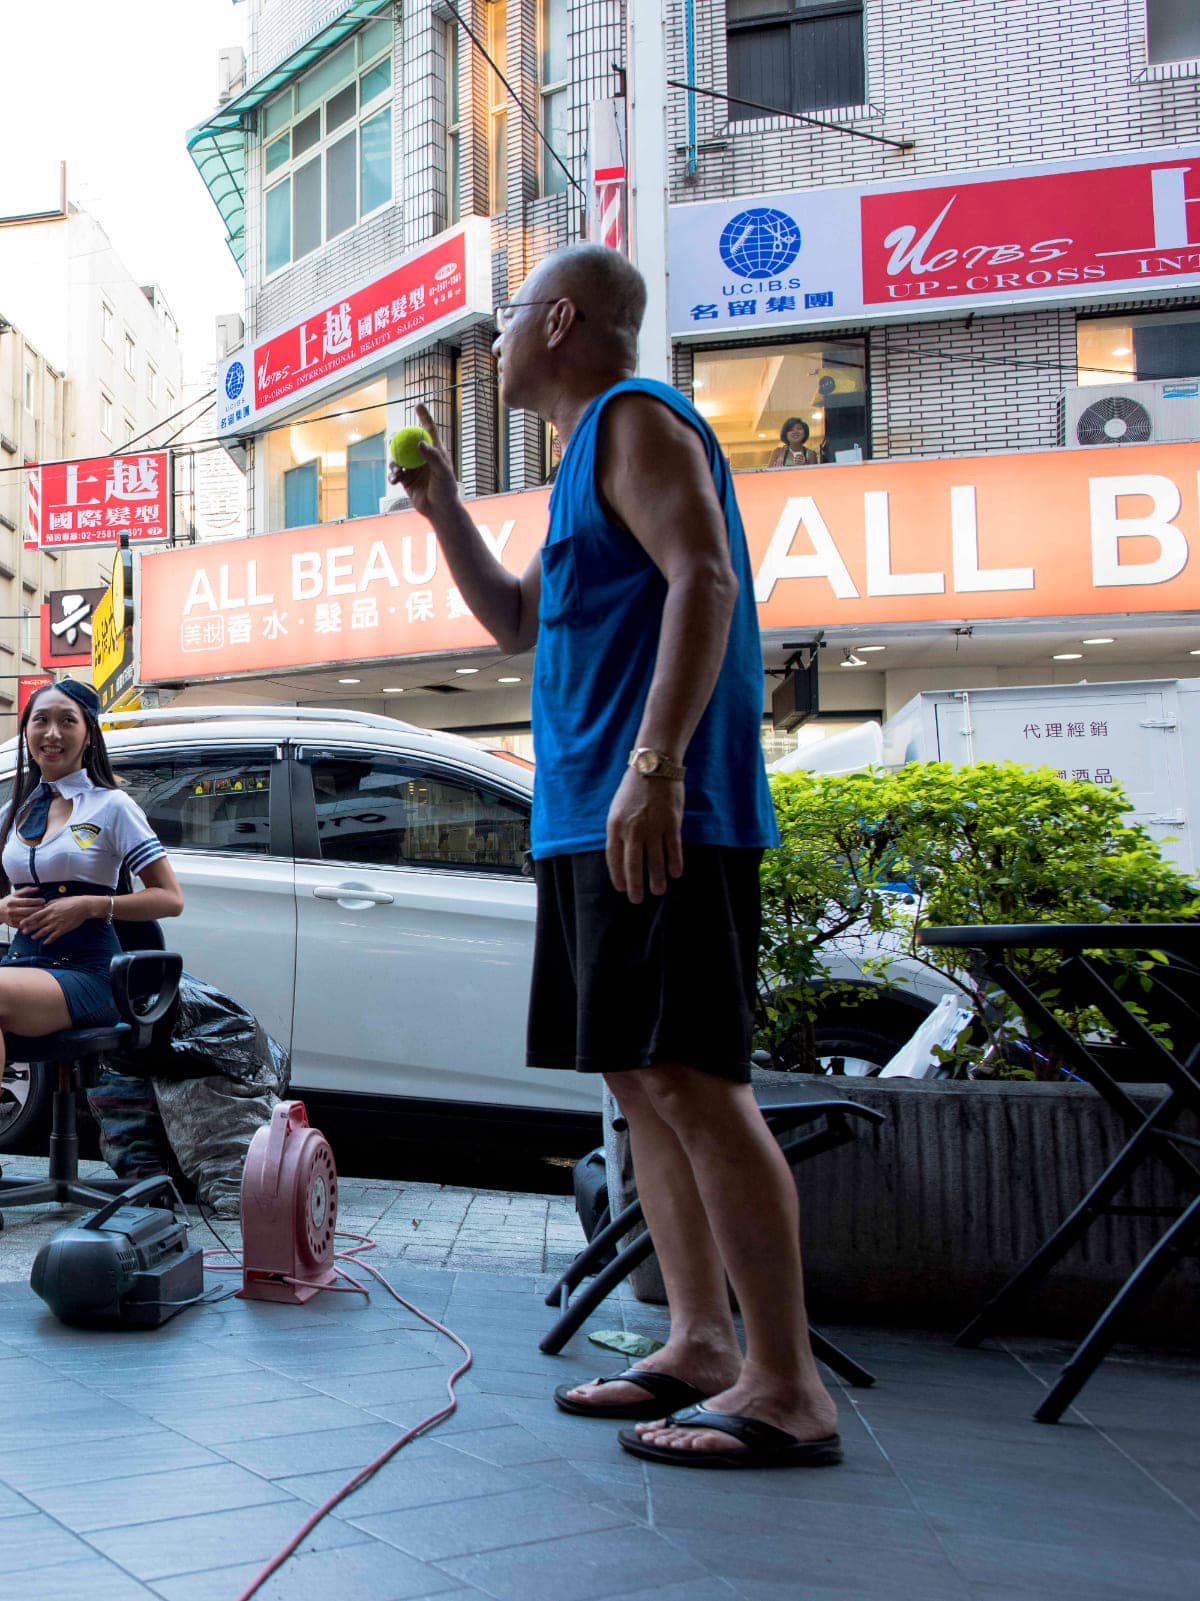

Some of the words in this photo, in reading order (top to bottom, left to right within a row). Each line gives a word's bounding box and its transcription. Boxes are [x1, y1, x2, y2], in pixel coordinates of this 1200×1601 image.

[690, 290, 834, 322] 名留集團
[887, 262, 1106, 299] UP-CROSS
[291, 302, 353, 375] 上越
[357, 284, 426, 341] 國際髮型
[296, 350, 356, 386] INTERNATIONAL
[359, 330, 392, 353] BEAUTY
[396, 313, 426, 334] SALON
[47, 457, 160, 508] 上越
[49, 503, 160, 531] 國際髮型
[753, 484, 1035, 603] ALL
[182, 558, 274, 617] ALL
[291, 518, 516, 601] BEAUY
[1022, 720, 1109, 740] 代理經銷
